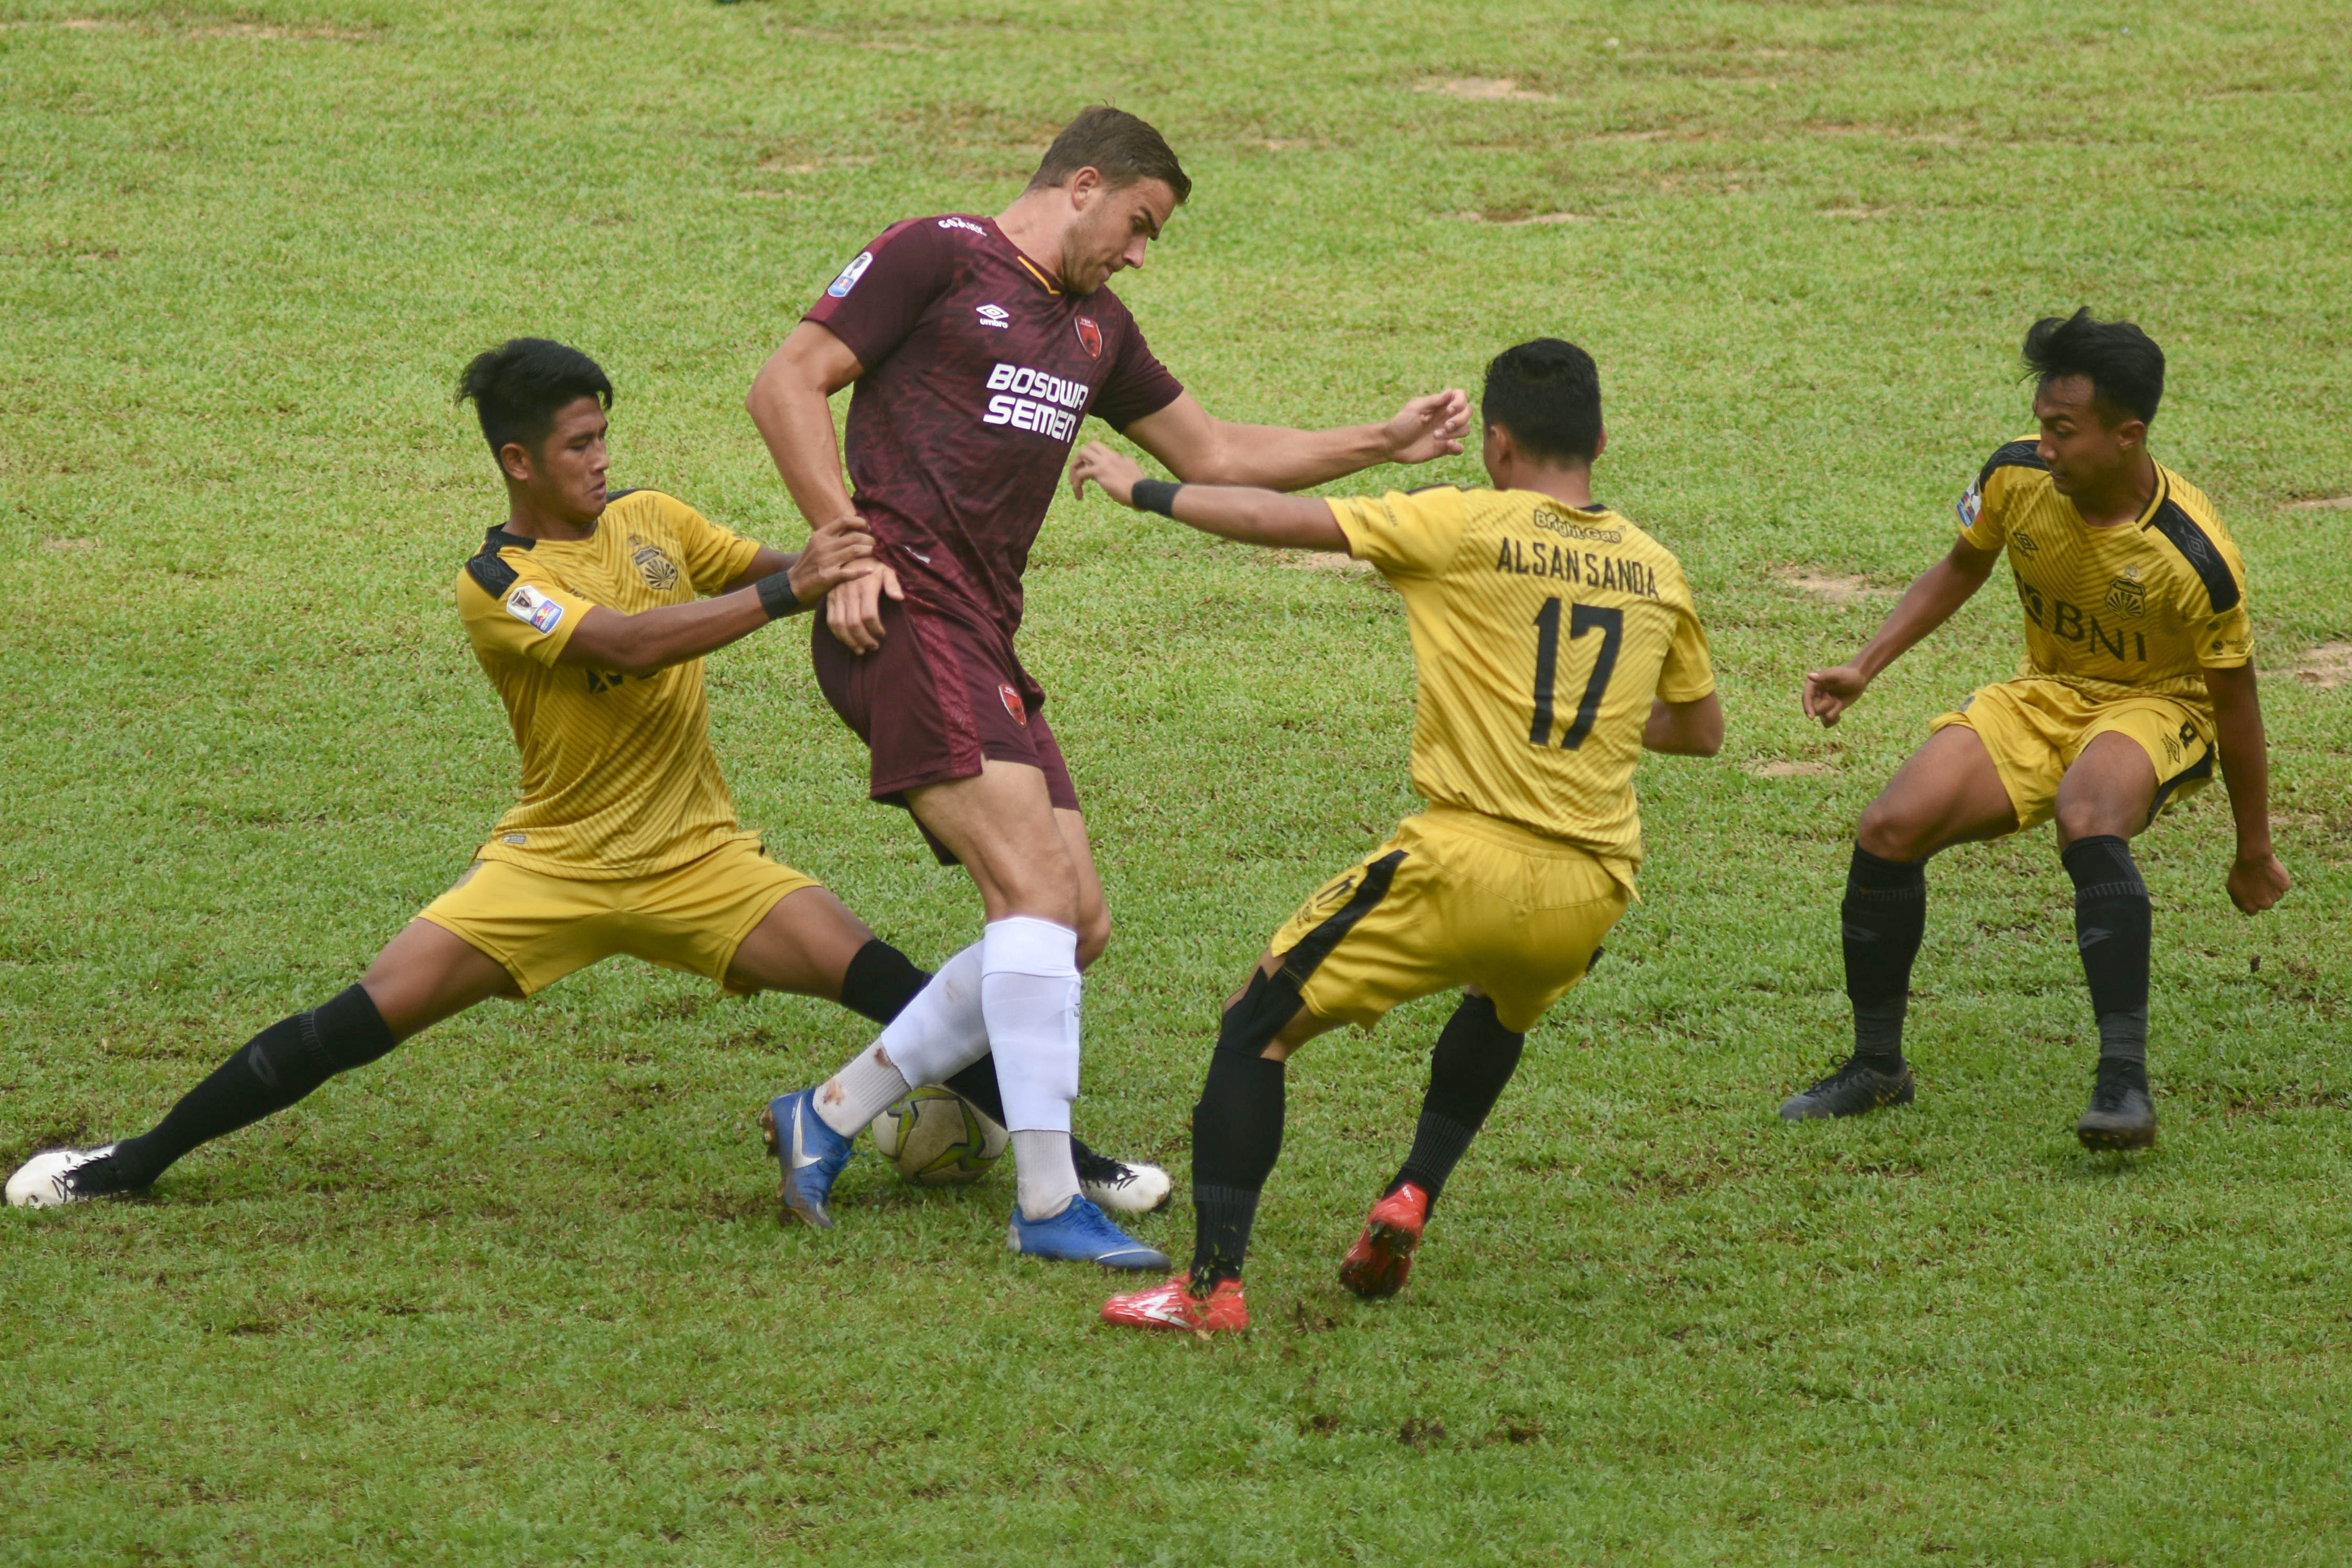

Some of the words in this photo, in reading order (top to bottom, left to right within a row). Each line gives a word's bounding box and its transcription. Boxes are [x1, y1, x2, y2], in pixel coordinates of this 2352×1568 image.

[980, 318, 1008, 329] umbro
[986, 363, 1089, 411] BOSOWA
[983, 394, 1076, 443] SEMEN
[1496, 537, 1580, 584] ALSAN
[1585, 553, 1661, 601] SANDA
[2053, 600, 2148, 662] BNI
[1530, 596, 1624, 751] 17
